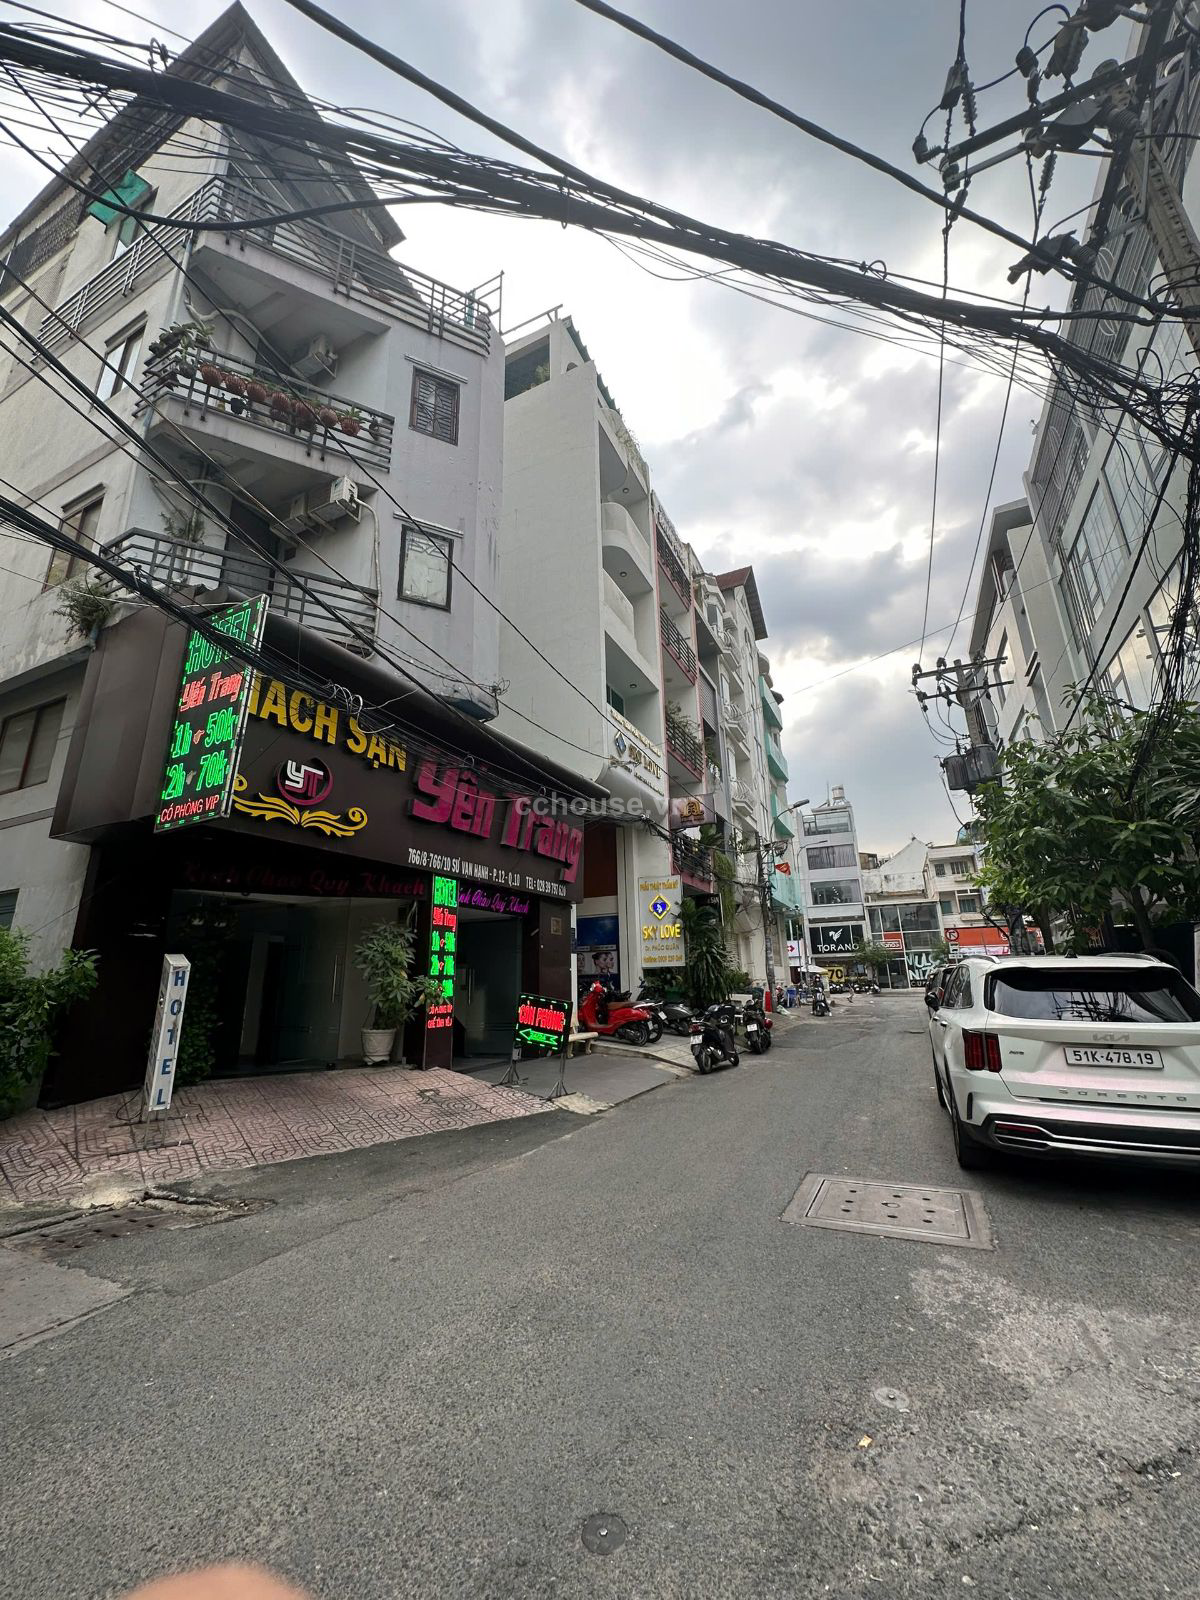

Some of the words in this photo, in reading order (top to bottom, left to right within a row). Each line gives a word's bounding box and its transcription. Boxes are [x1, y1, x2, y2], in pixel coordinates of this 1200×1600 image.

[180, 676, 206, 711] Yến
[208, 671, 244, 702] Trang
[172, 721, 192, 758] 1h
[205, 706, 239, 748] 50k
[164, 762, 186, 800] 2h
[196, 749, 228, 792] 70k
[161, 802, 174, 822] CÓ
[174, 798, 203, 819] PHÒNG
[205, 794, 220, 811] VIP
[500, 790, 583, 884] Trang
[408, 847, 451, 871] 766/8-766/10
[461, 861, 473, 879] VẠN
[508, 873, 520, 886] Q.10
[643, 925, 658, 940] SKY
[660, 923, 682, 939] LOVE
[817, 943, 860, 952] TORANO
[828, 968, 844, 980] 70
[519, 1000, 536, 1025] CÒN
[536, 1005, 565, 1032] PHÒNG
[156, 970, 186, 1106] HOTEL
[1073, 1050, 1154, 1065] 51K-478.19
[1059, 1088, 1188, 1102] SORENTO
